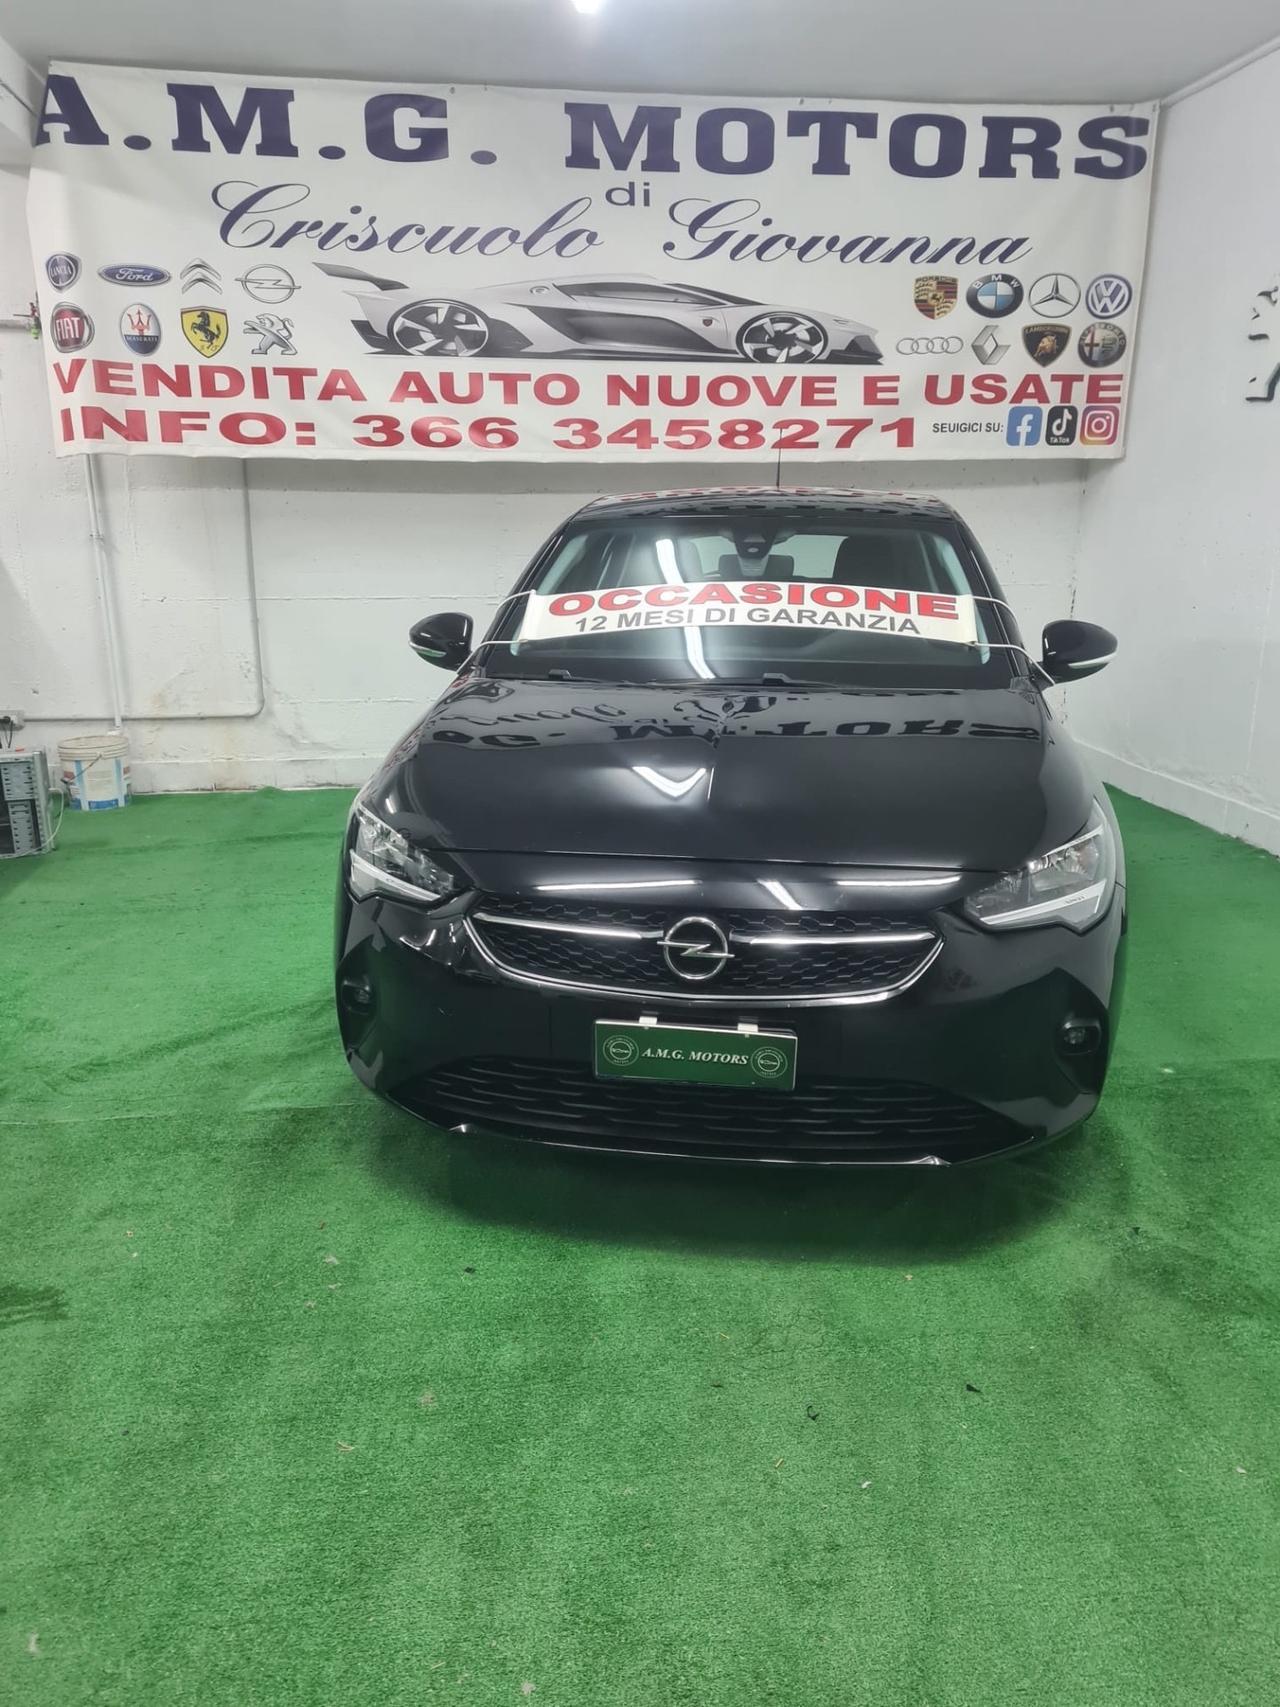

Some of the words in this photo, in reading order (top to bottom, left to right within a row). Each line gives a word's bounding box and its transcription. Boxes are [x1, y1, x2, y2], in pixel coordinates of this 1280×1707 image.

[36, 74, 497, 165] A.M.G.
[564, 102, 1150, 180] MOTORS
[605, 182, 650, 207] di
[211, 181, 603, 259] Criscuolo
[663, 198, 1032, 264] Giovanna
[116, 268, 153, 281] Ford
[973, 274, 1021, 289] BMW
[55, 317, 81, 341] FIAT
[53, 358, 367, 402] VENDITA
[389, 371, 581, 406] AUTO
[606, 374, 838, 407] NUOVE
[863, 374, 900, 406] E
[923, 373, 1125, 406] USATE
[60, 406, 316, 446] INFO:
[352, 414, 520, 449] 366
[552, 417, 915, 449] 3458271
[932, 422, 982, 433] SEUIGICI
[985, 422, 1004, 433] SU:
[548, 583, 960, 620] OCCASIONE
[575, 616, 607, 633] 12
[617, 608, 694, 629] MESI
[705, 607, 736, 624] DI
[747, 607, 921, 635] GARANZIA
[641, 1047, 685, 1061] A.M.G.
[688, 1050, 749, 1066] MOTORS
